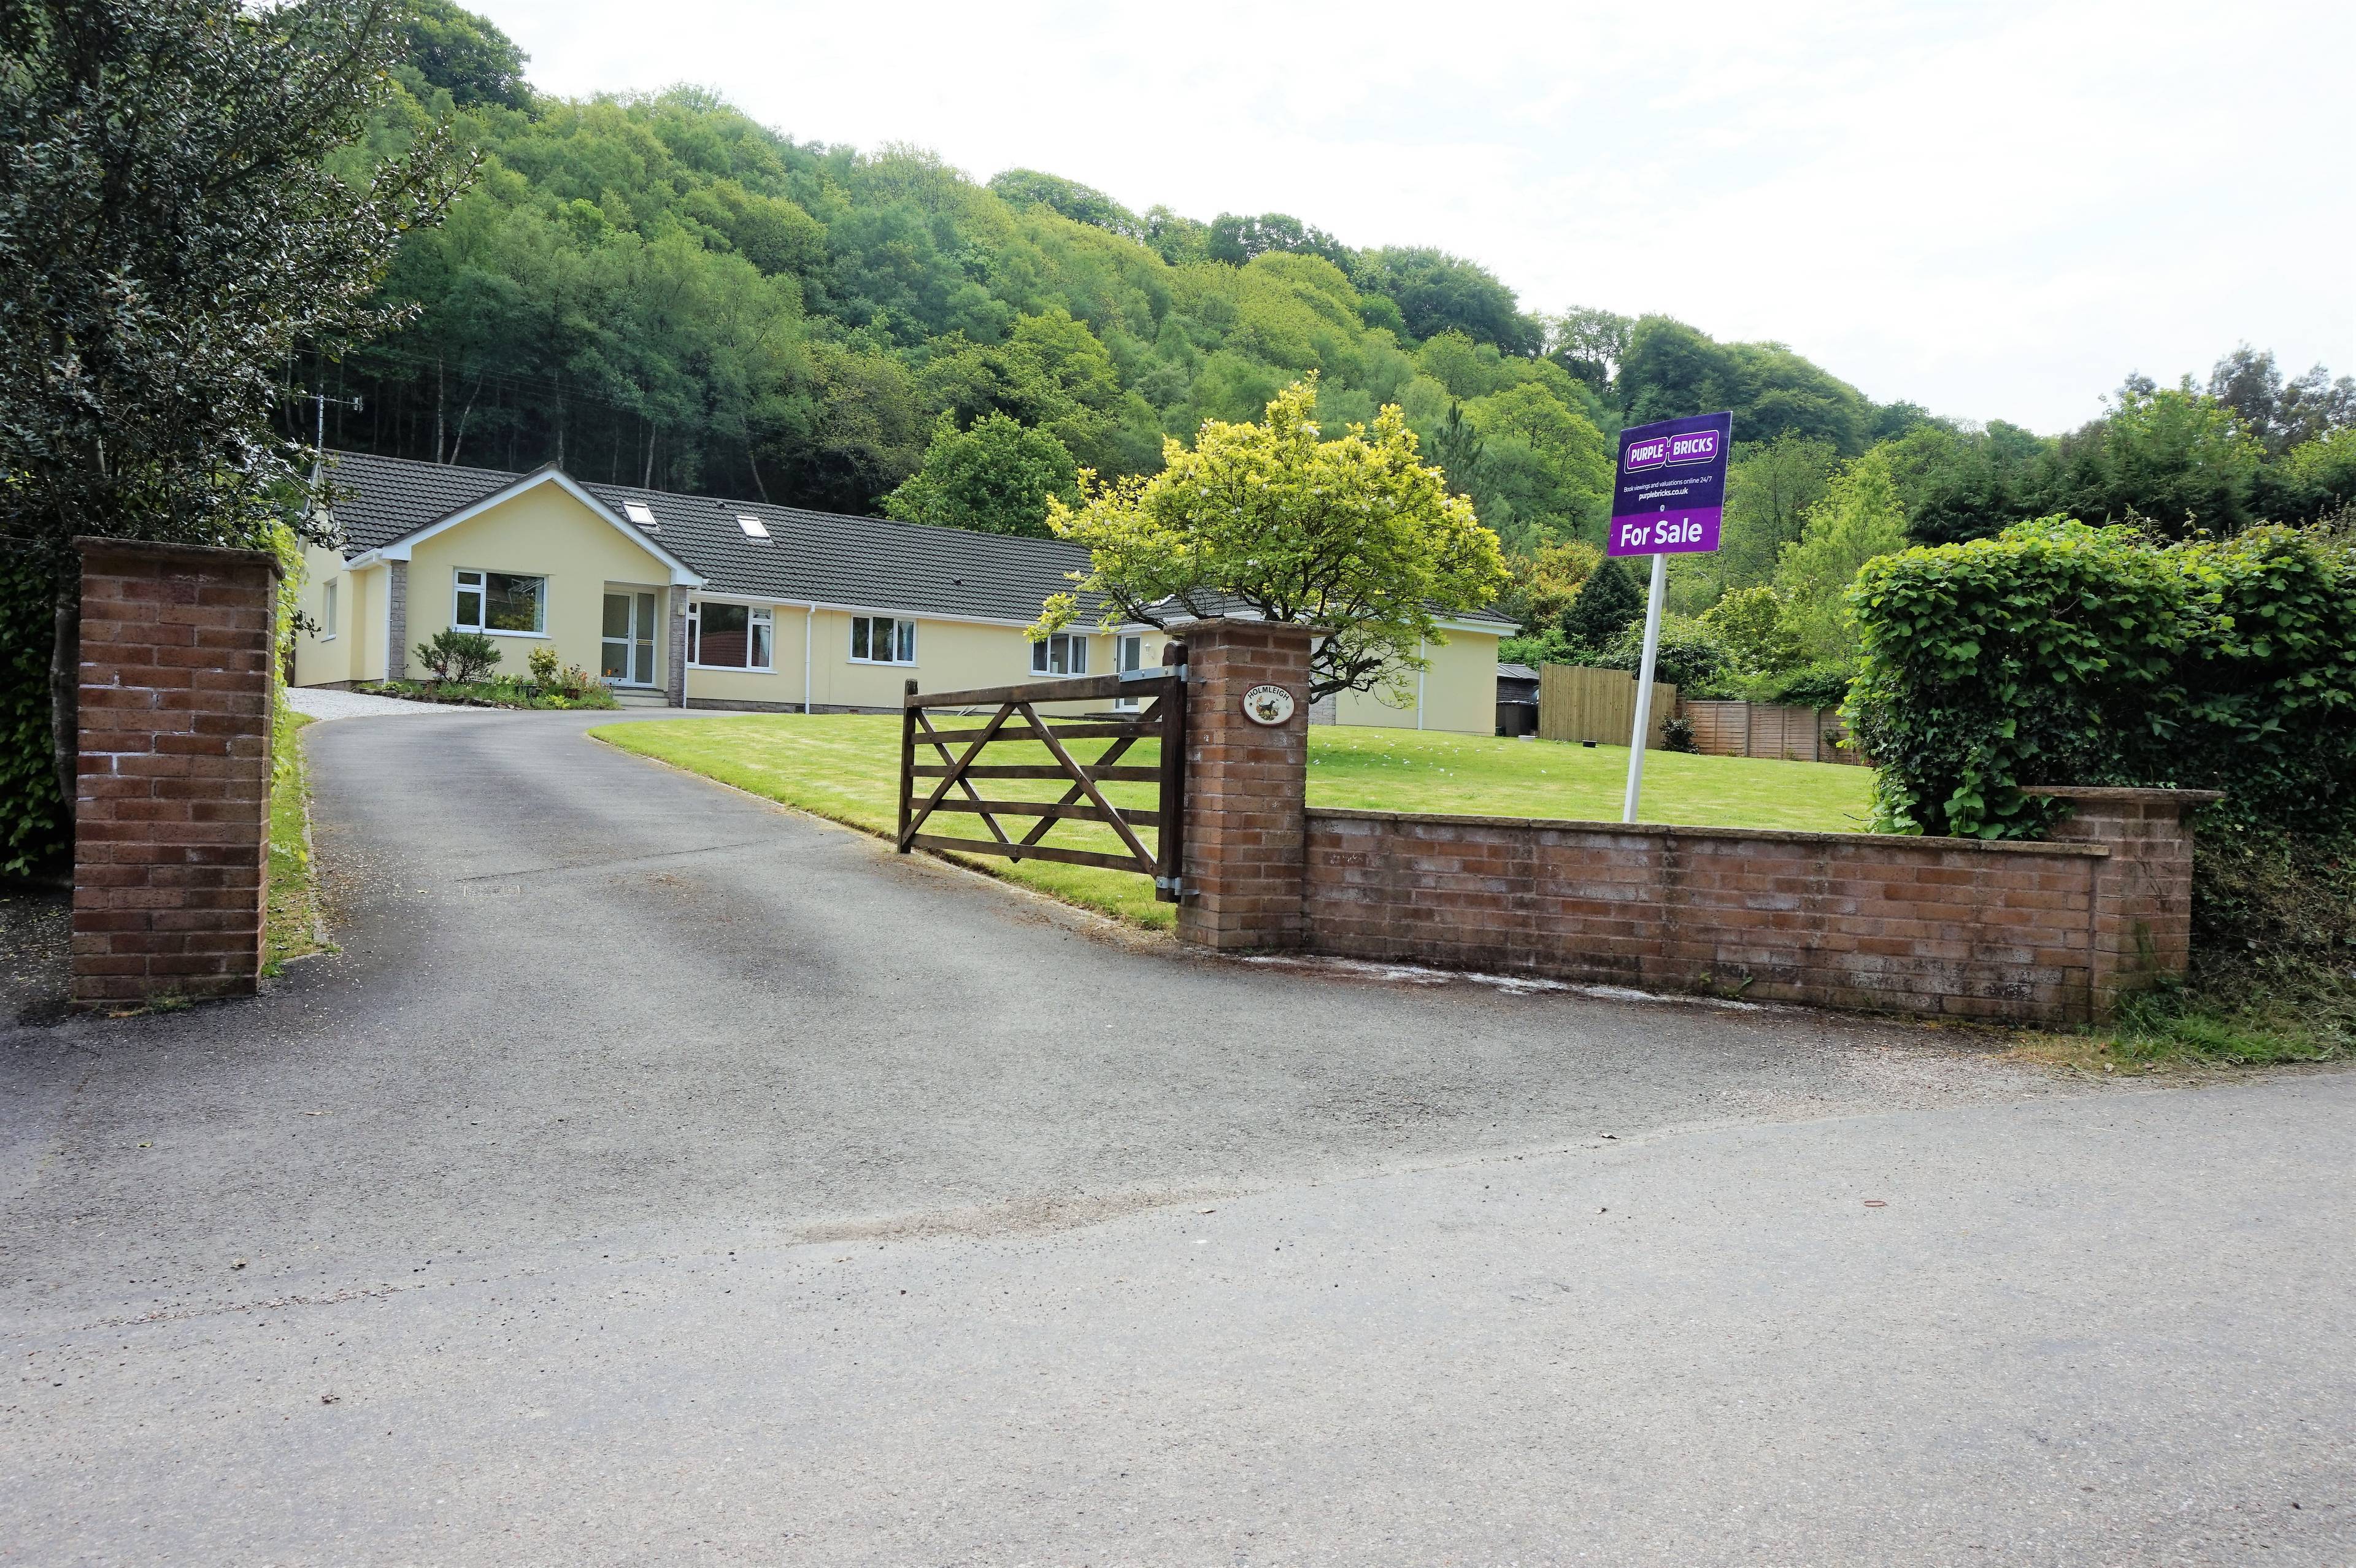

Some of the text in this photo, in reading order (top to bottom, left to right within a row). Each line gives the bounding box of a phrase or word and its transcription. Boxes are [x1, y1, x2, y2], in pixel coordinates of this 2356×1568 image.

[1631, 437, 1713, 463] PURPLE BRICKS
[1659, 479, 1683, 488] valuations
[1639, 487, 1688, 501] purplebricks.co.uk
[1620, 517, 1703, 547] For Sale
[1247, 686, 1290, 701] HOLMLEIGH
